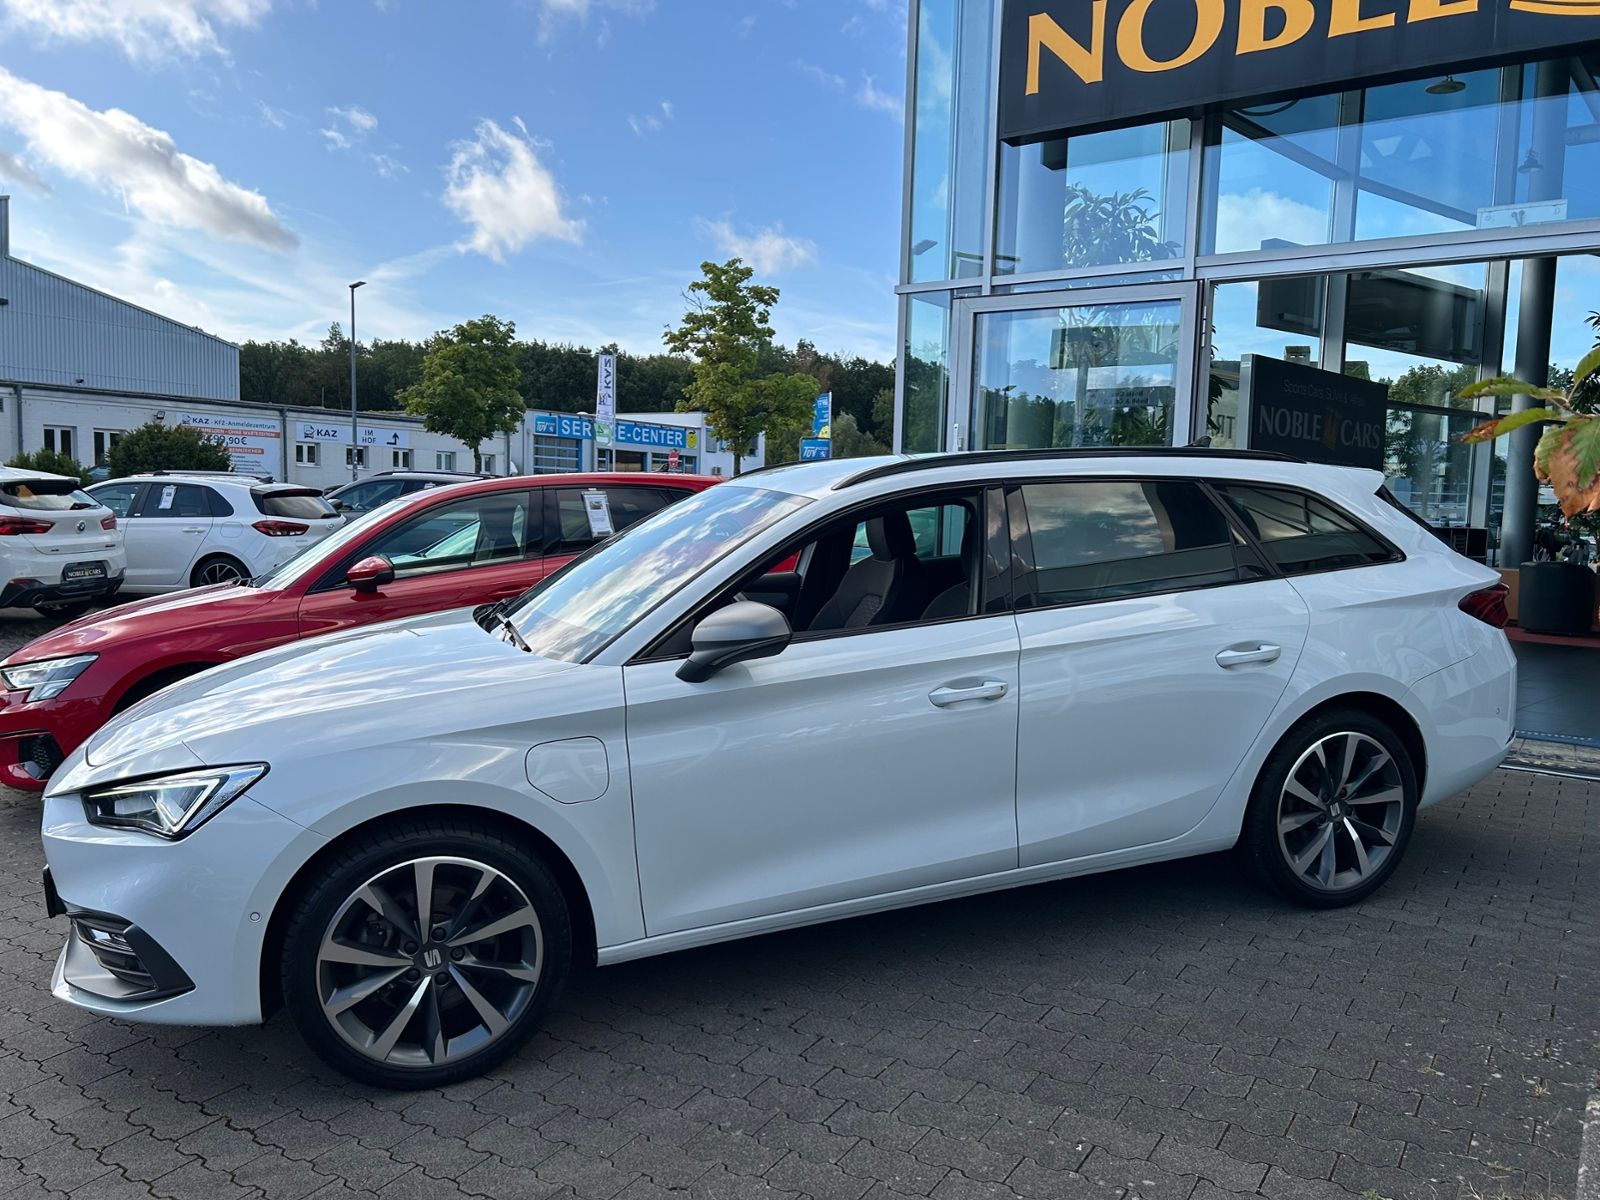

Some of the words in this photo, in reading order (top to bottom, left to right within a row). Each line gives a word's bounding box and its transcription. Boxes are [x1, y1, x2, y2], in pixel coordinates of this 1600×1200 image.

[192, 417, 210, 425] KAZ
[1258, 405, 1321, 441] NOBLE
[1340, 419, 1381, 449] CARS
[316, 429, 338, 438] KAZ
[561, 419, 683, 446] SERE-CENTER
